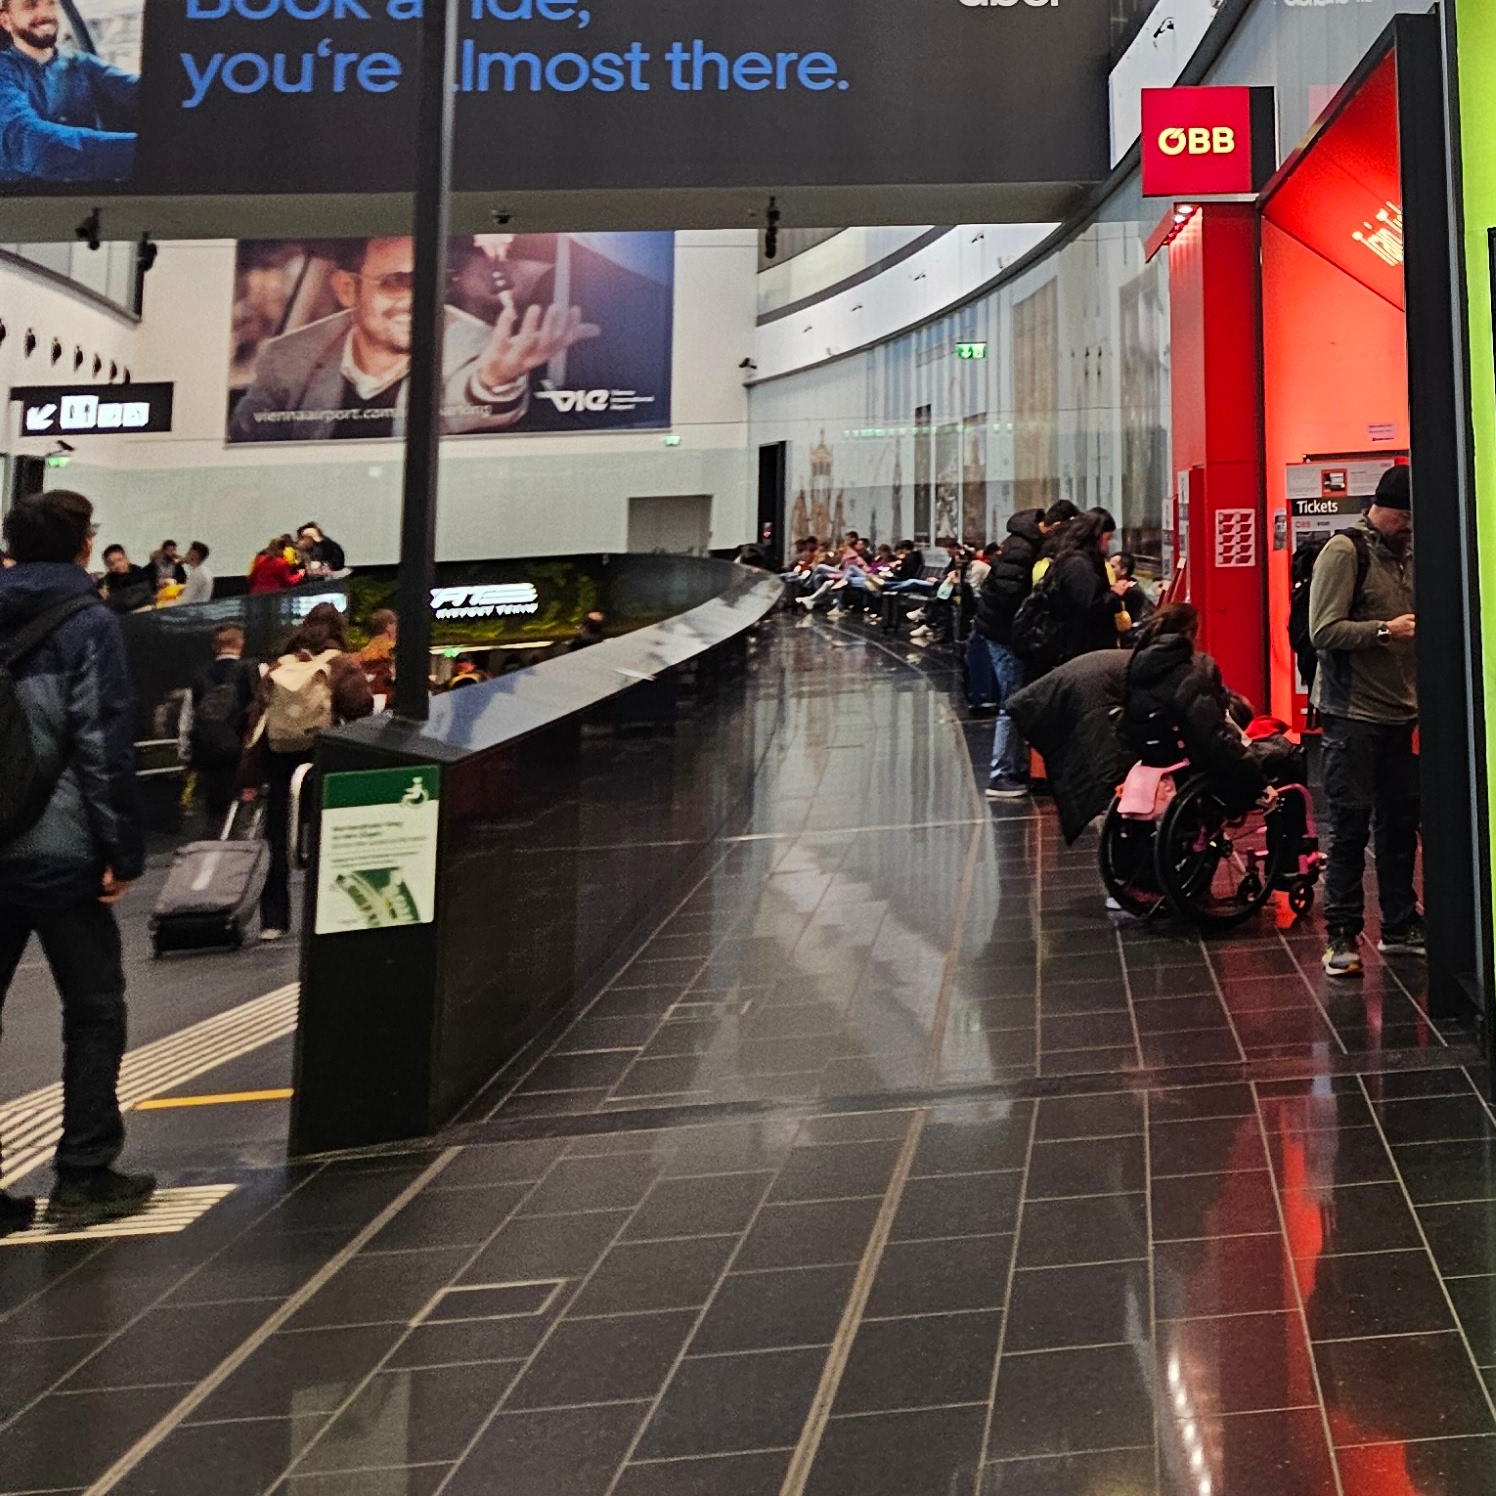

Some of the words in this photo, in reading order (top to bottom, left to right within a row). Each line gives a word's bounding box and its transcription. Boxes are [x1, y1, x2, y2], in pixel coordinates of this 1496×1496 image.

[454, 39, 651, 93] lmost
[665, 39, 850, 92] there.
[1296, 499, 1339, 514] Tickets
